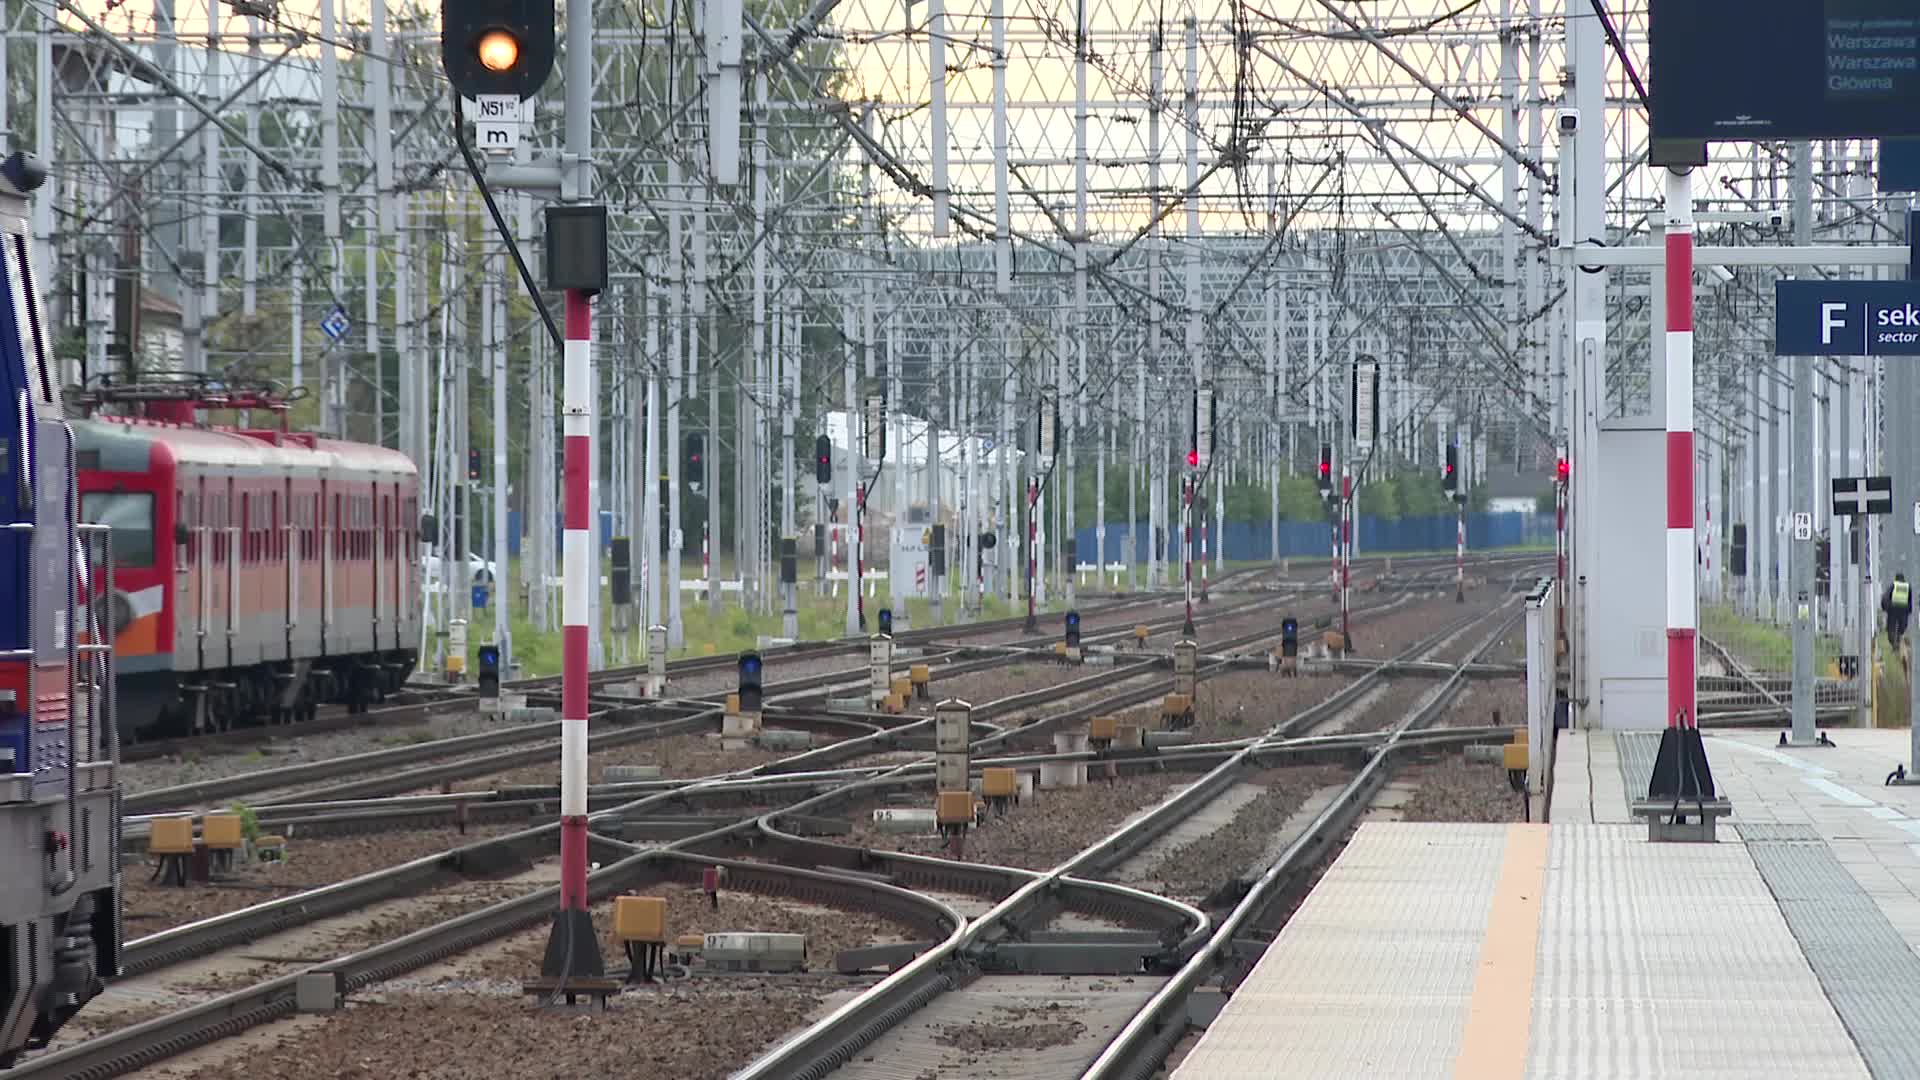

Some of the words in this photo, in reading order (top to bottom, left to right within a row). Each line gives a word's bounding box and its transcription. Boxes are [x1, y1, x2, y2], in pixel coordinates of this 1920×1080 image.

[1827, 32, 1917, 49] Warszawa
[1827, 55, 1917, 70] Warszawa
[481, 101, 504, 116] N51
[487, 130, 508, 143] m
[1877, 303, 1920, 326] sek
[1822, 303, 1847, 344] F
[1877, 332, 1919, 343] sector
[1797, 514, 1809, 525] 78
[1799, 527, 1808, 538] 19
